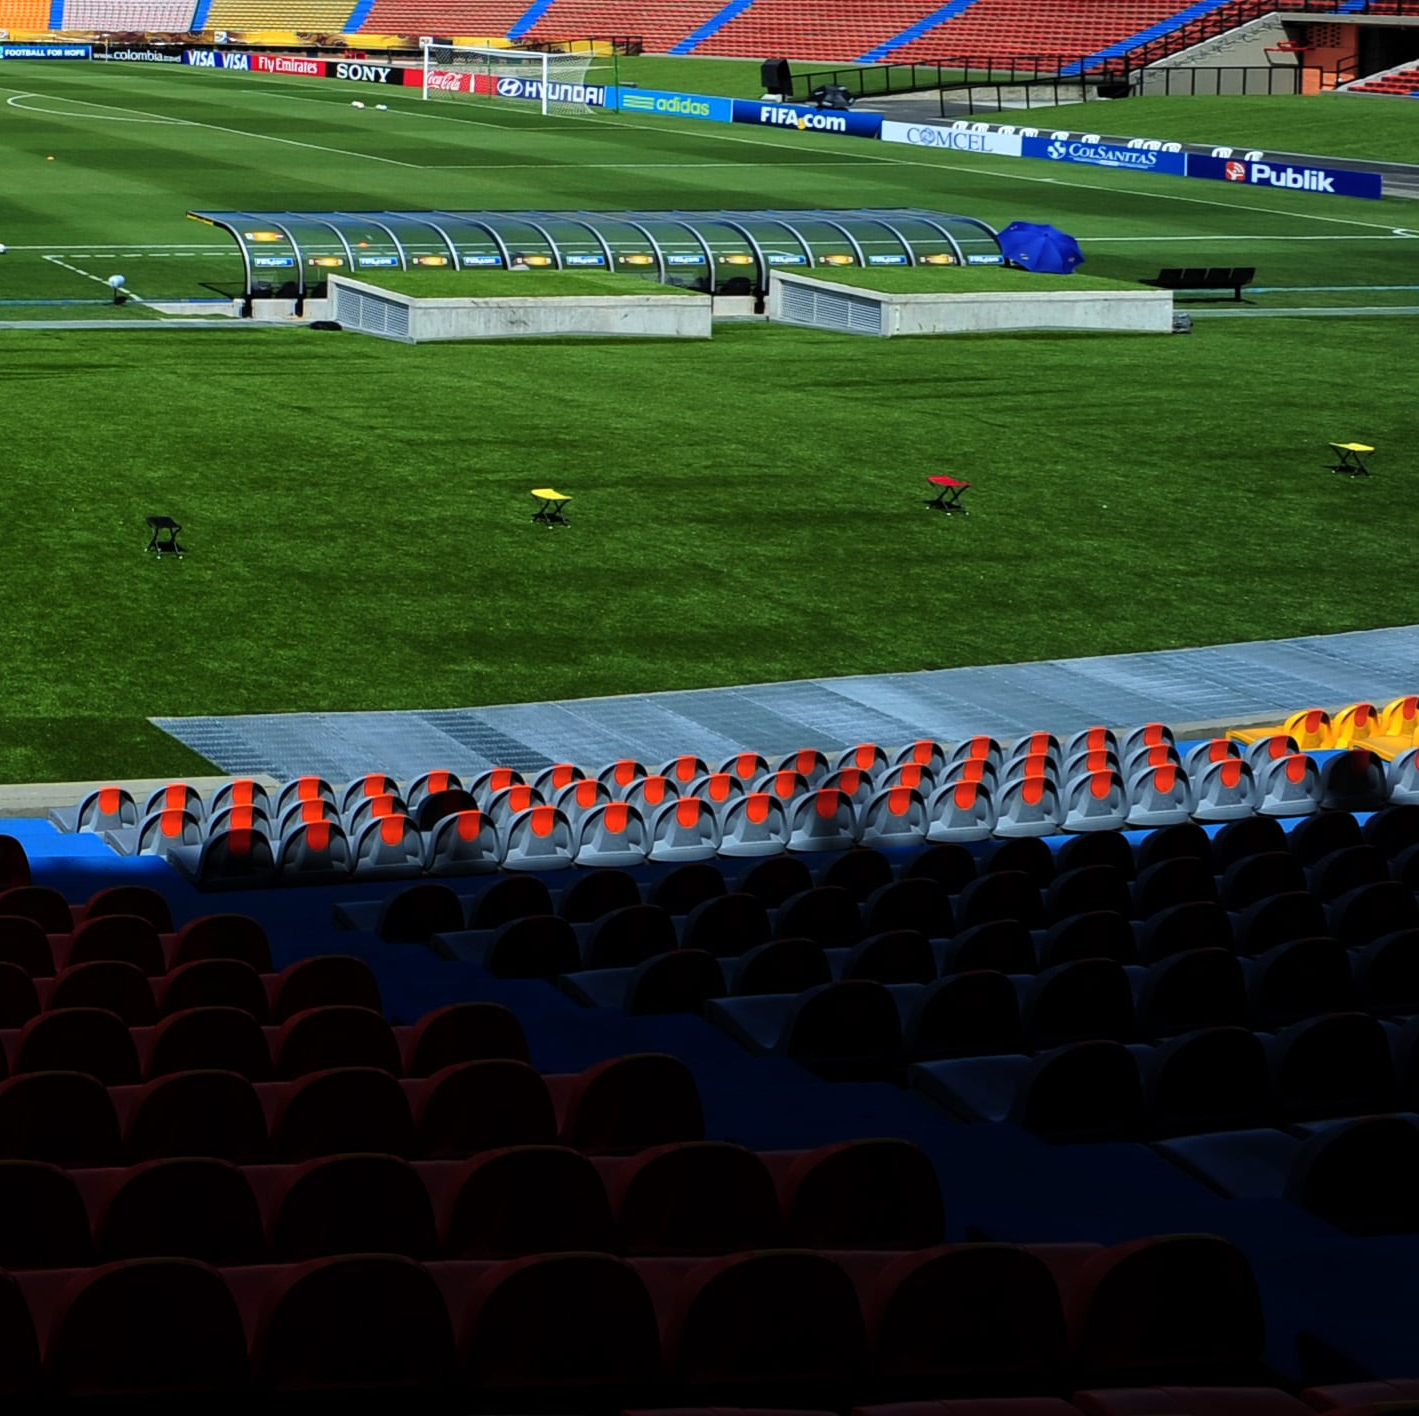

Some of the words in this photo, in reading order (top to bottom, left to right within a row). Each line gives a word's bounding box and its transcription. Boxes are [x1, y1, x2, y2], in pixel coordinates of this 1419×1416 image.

[4, 49, 45, 57] FOOTBALL
[47, 49, 63, 57] FOR
[64, 49, 86, 57] HOPE
[187, 50, 215, 67] VISA
[221, 53, 249, 71] VISA
[258, 56, 275, 73] Fly
[275, 57, 318, 74] Emirates
[336, 63, 391, 83] SONY
[656, 96, 710, 116] adidas
[760, 106, 846, 131] FIFA.com
[1251, 163, 1335, 192] Publik
